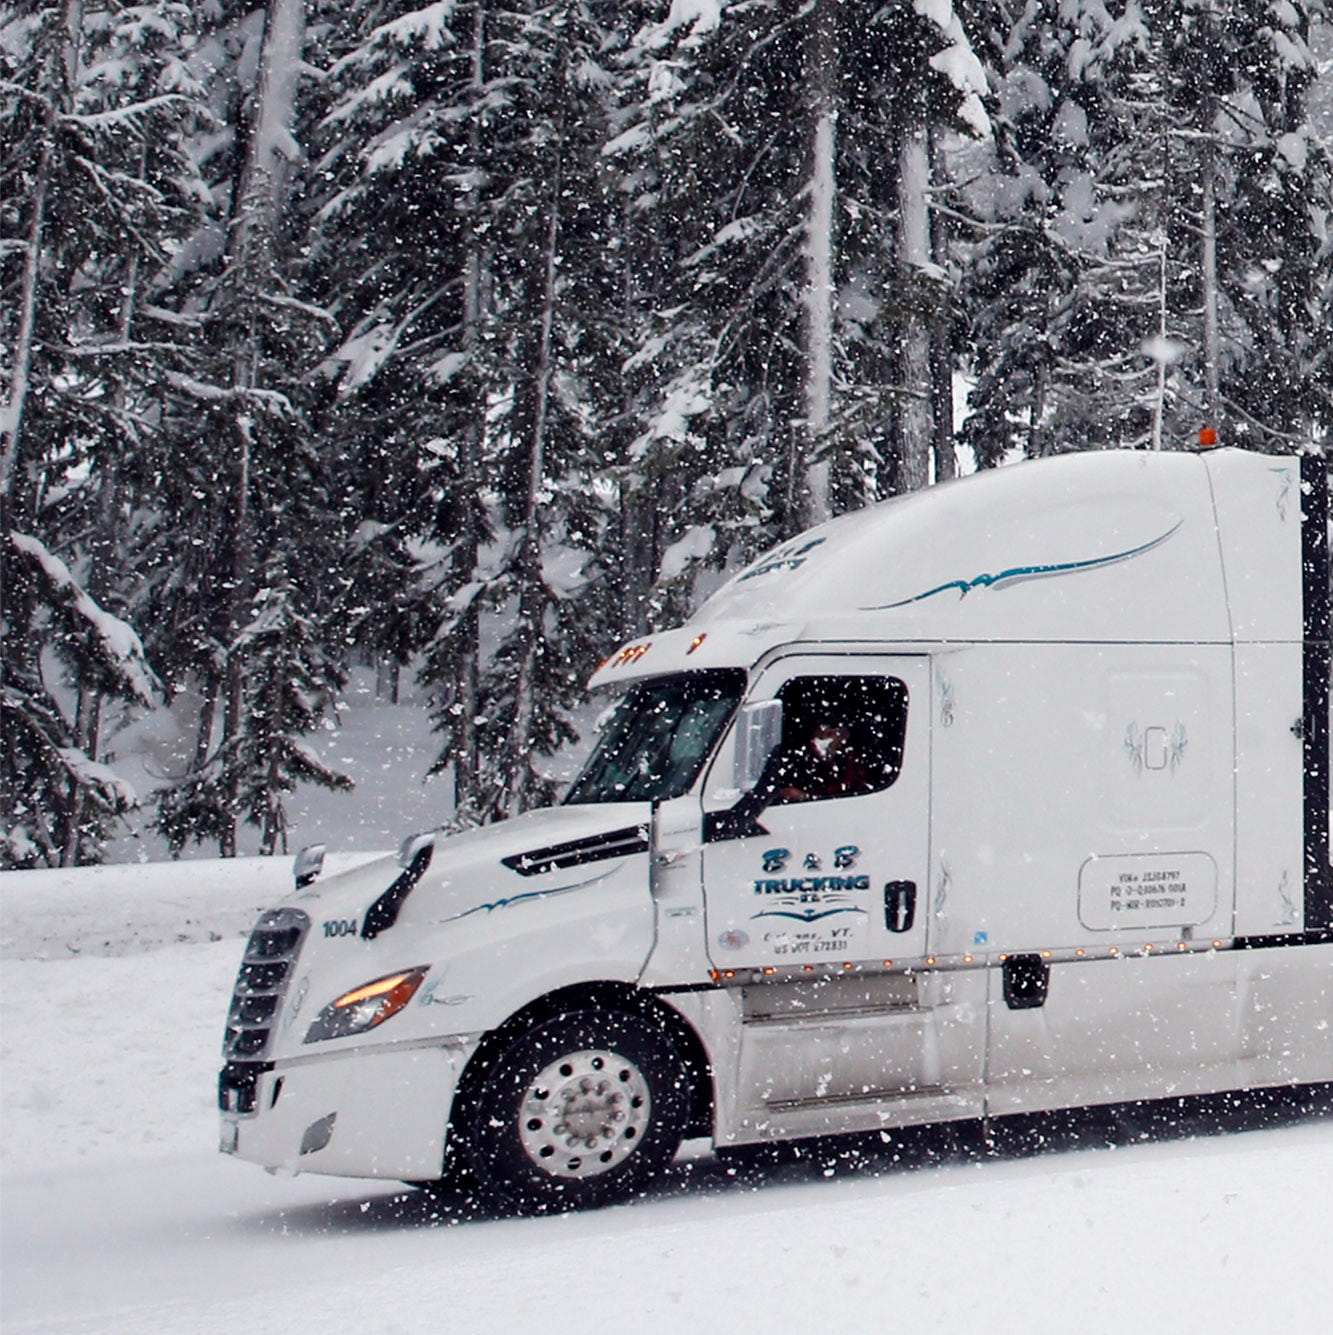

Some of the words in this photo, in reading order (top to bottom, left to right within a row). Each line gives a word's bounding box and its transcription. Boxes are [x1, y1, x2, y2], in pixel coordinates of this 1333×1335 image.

[761, 847, 791, 873] B
[803, 852, 822, 871] &
[833, 844, 860, 871] B
[753, 874, 871, 895] TRUCKING
[322, 918, 358, 939] 1004
